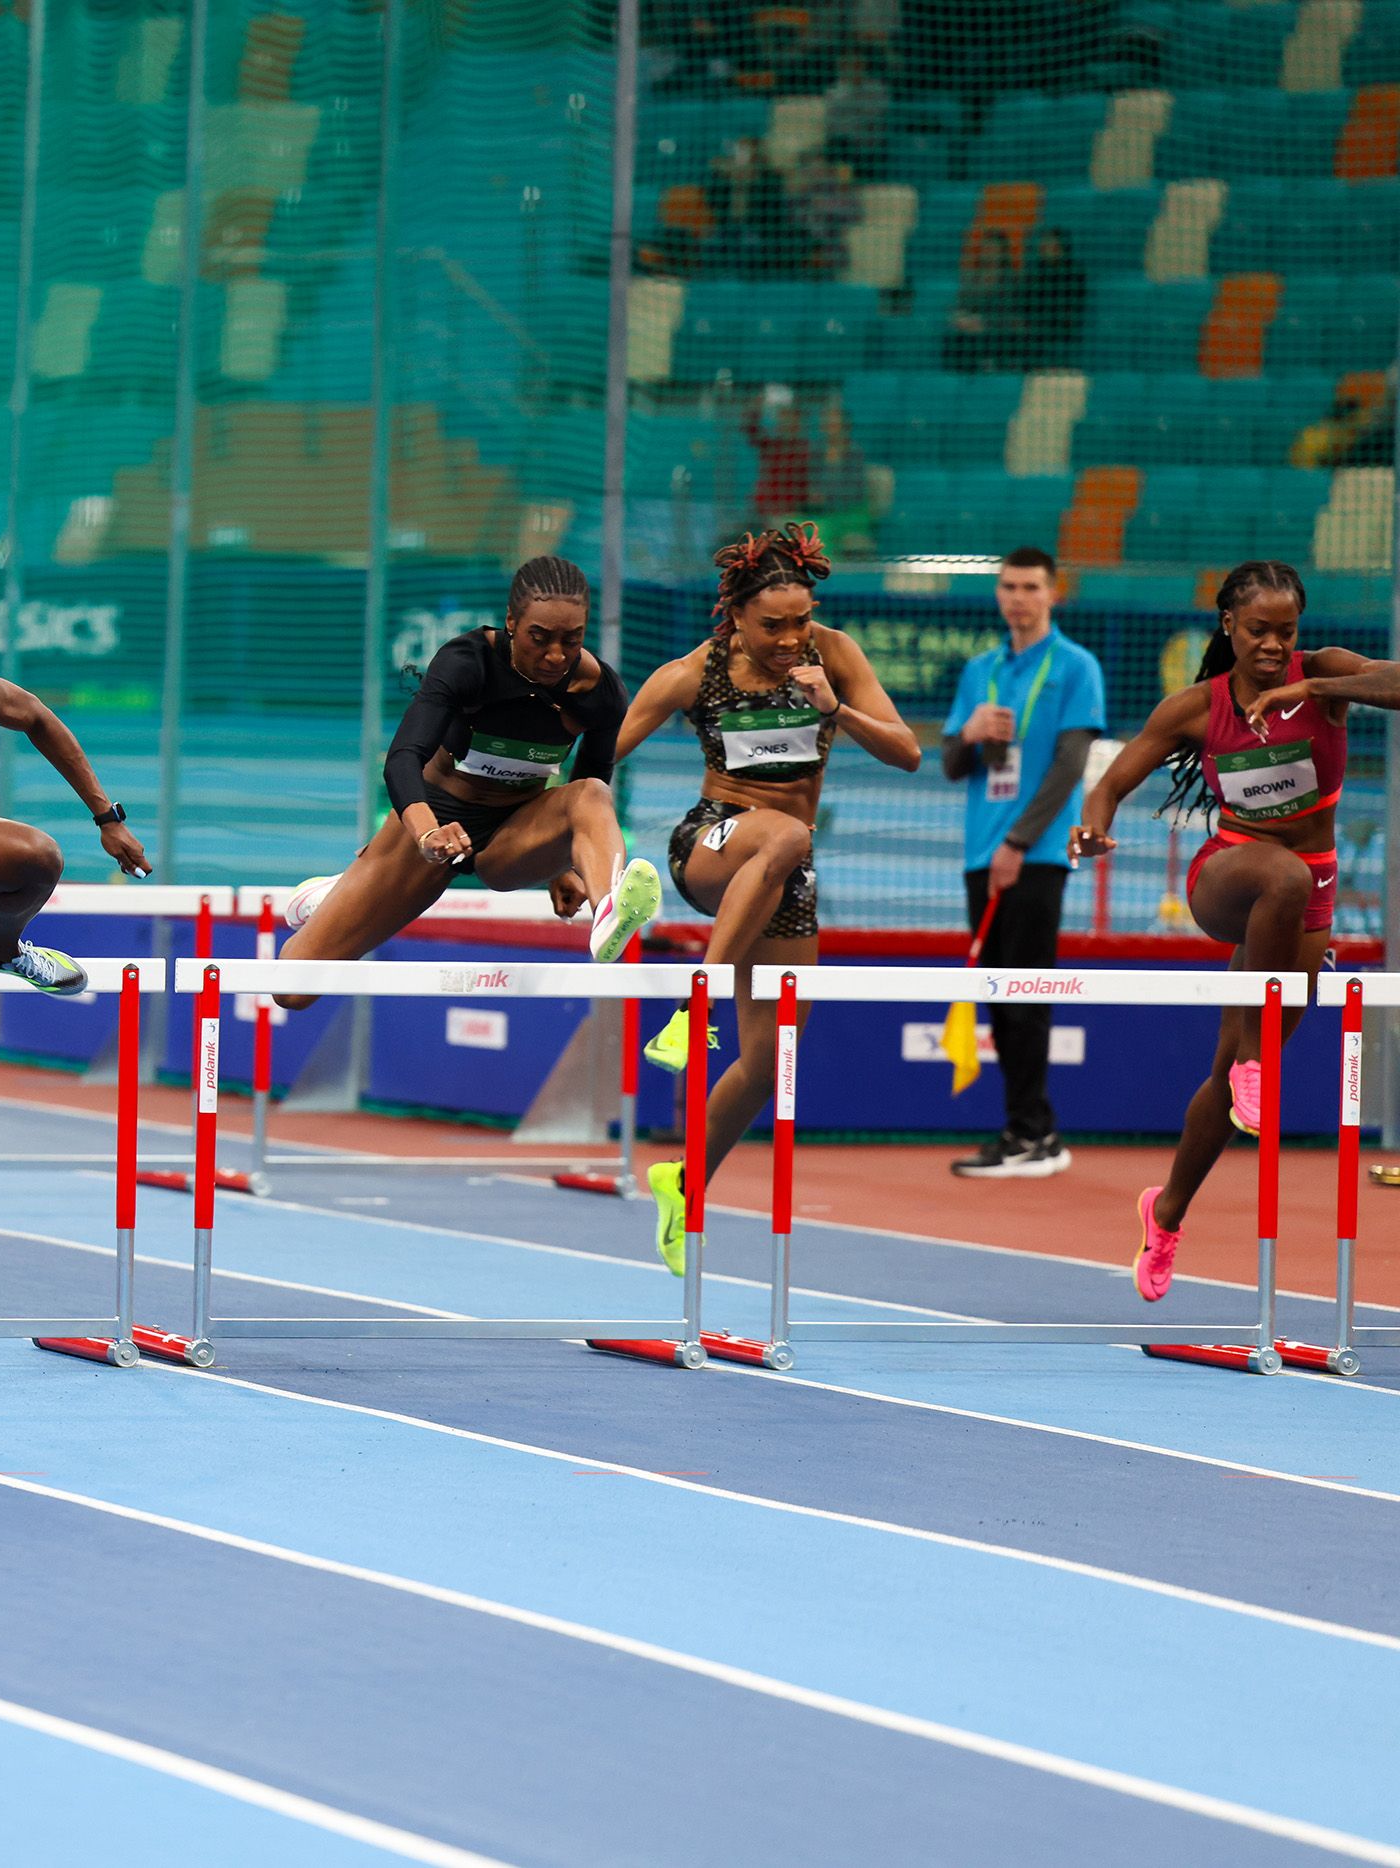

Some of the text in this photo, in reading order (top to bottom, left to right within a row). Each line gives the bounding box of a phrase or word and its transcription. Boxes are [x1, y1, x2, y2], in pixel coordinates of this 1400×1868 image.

[748, 743, 789, 757] JONES
[1242, 778, 1296, 798] BROWN
[1282, 802, 1299, 815] 24
[1006, 976, 1084, 997] polanik
[205, 1041, 216, 1089] polanik
[783, 1048, 794, 1096] polanik
[1348, 1055, 1359, 1102] polanik
